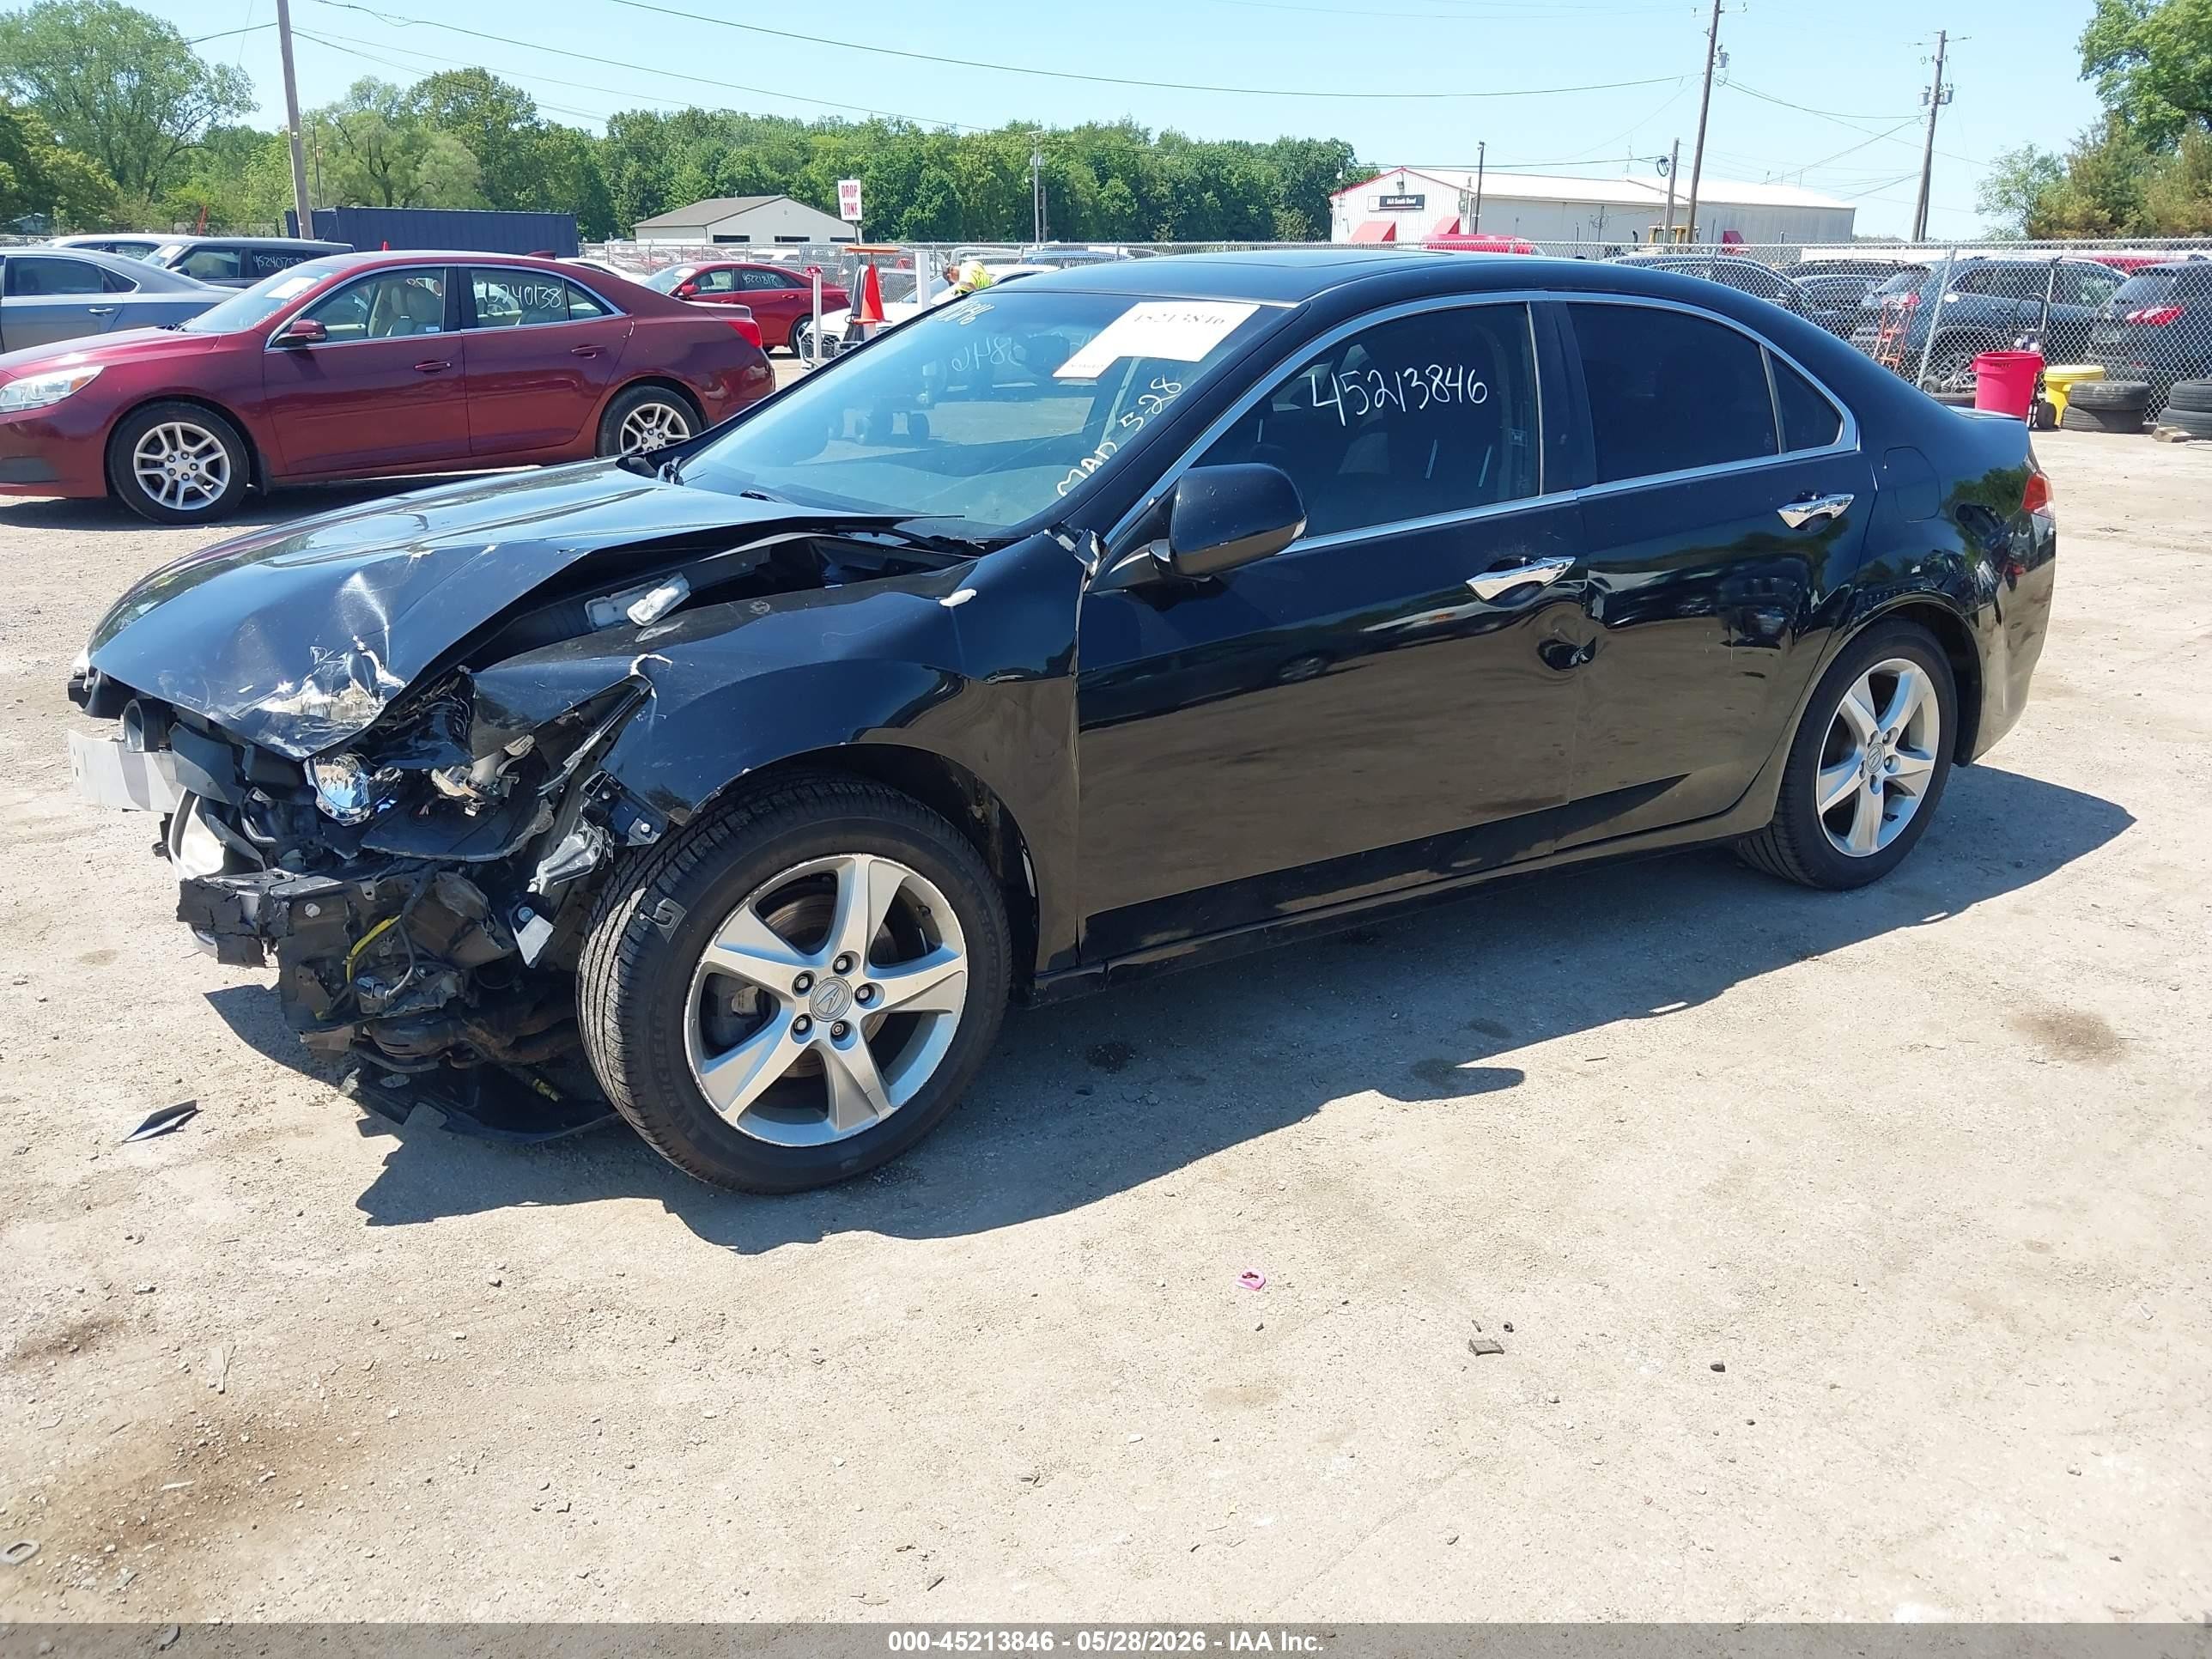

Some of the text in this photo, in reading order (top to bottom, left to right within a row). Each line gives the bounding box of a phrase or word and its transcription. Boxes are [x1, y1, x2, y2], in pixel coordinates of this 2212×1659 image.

[841, 185, 858, 198] DROP
[844, 203, 858, 216] ZONE
[1310, 363, 1488, 427] 45213846
